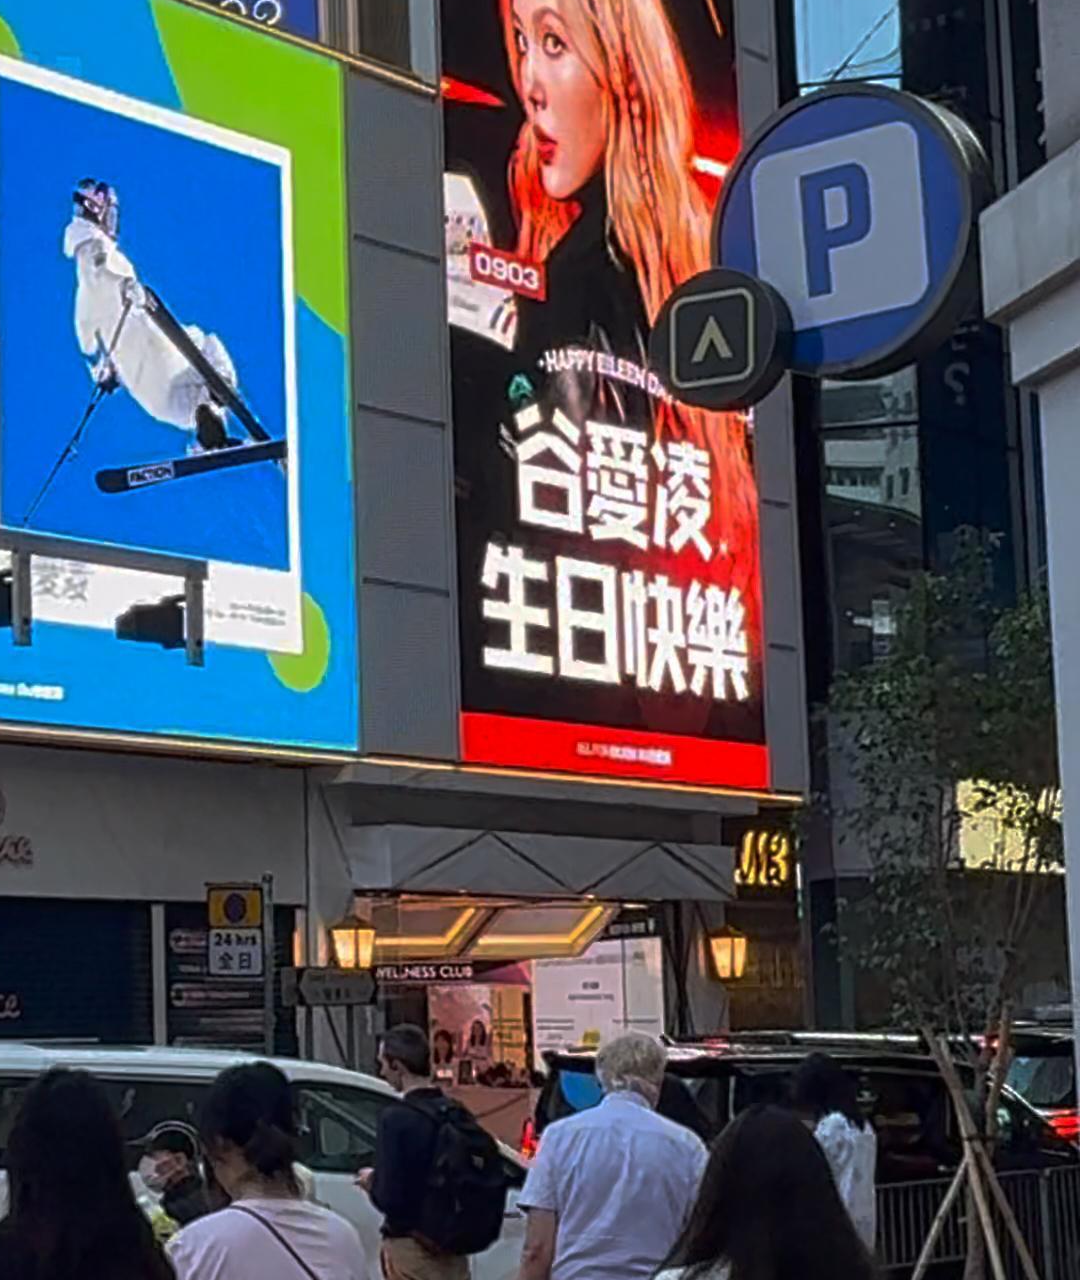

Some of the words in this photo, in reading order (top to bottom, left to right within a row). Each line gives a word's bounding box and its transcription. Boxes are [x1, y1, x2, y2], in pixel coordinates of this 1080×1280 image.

[800, 163, 872, 300] P
[474, 251, 540, 291] 0903
[544, 348, 596, 372] HAPPY
[514, 403, 713, 561] 谷愛凌
[480, 541, 750, 701] 生日快樂
[214, 933, 232, 947] 24
[235, 932, 258, 947] hrs
[218, 951, 253, 970] 全日
[439, 965, 474, 979] CLUB
